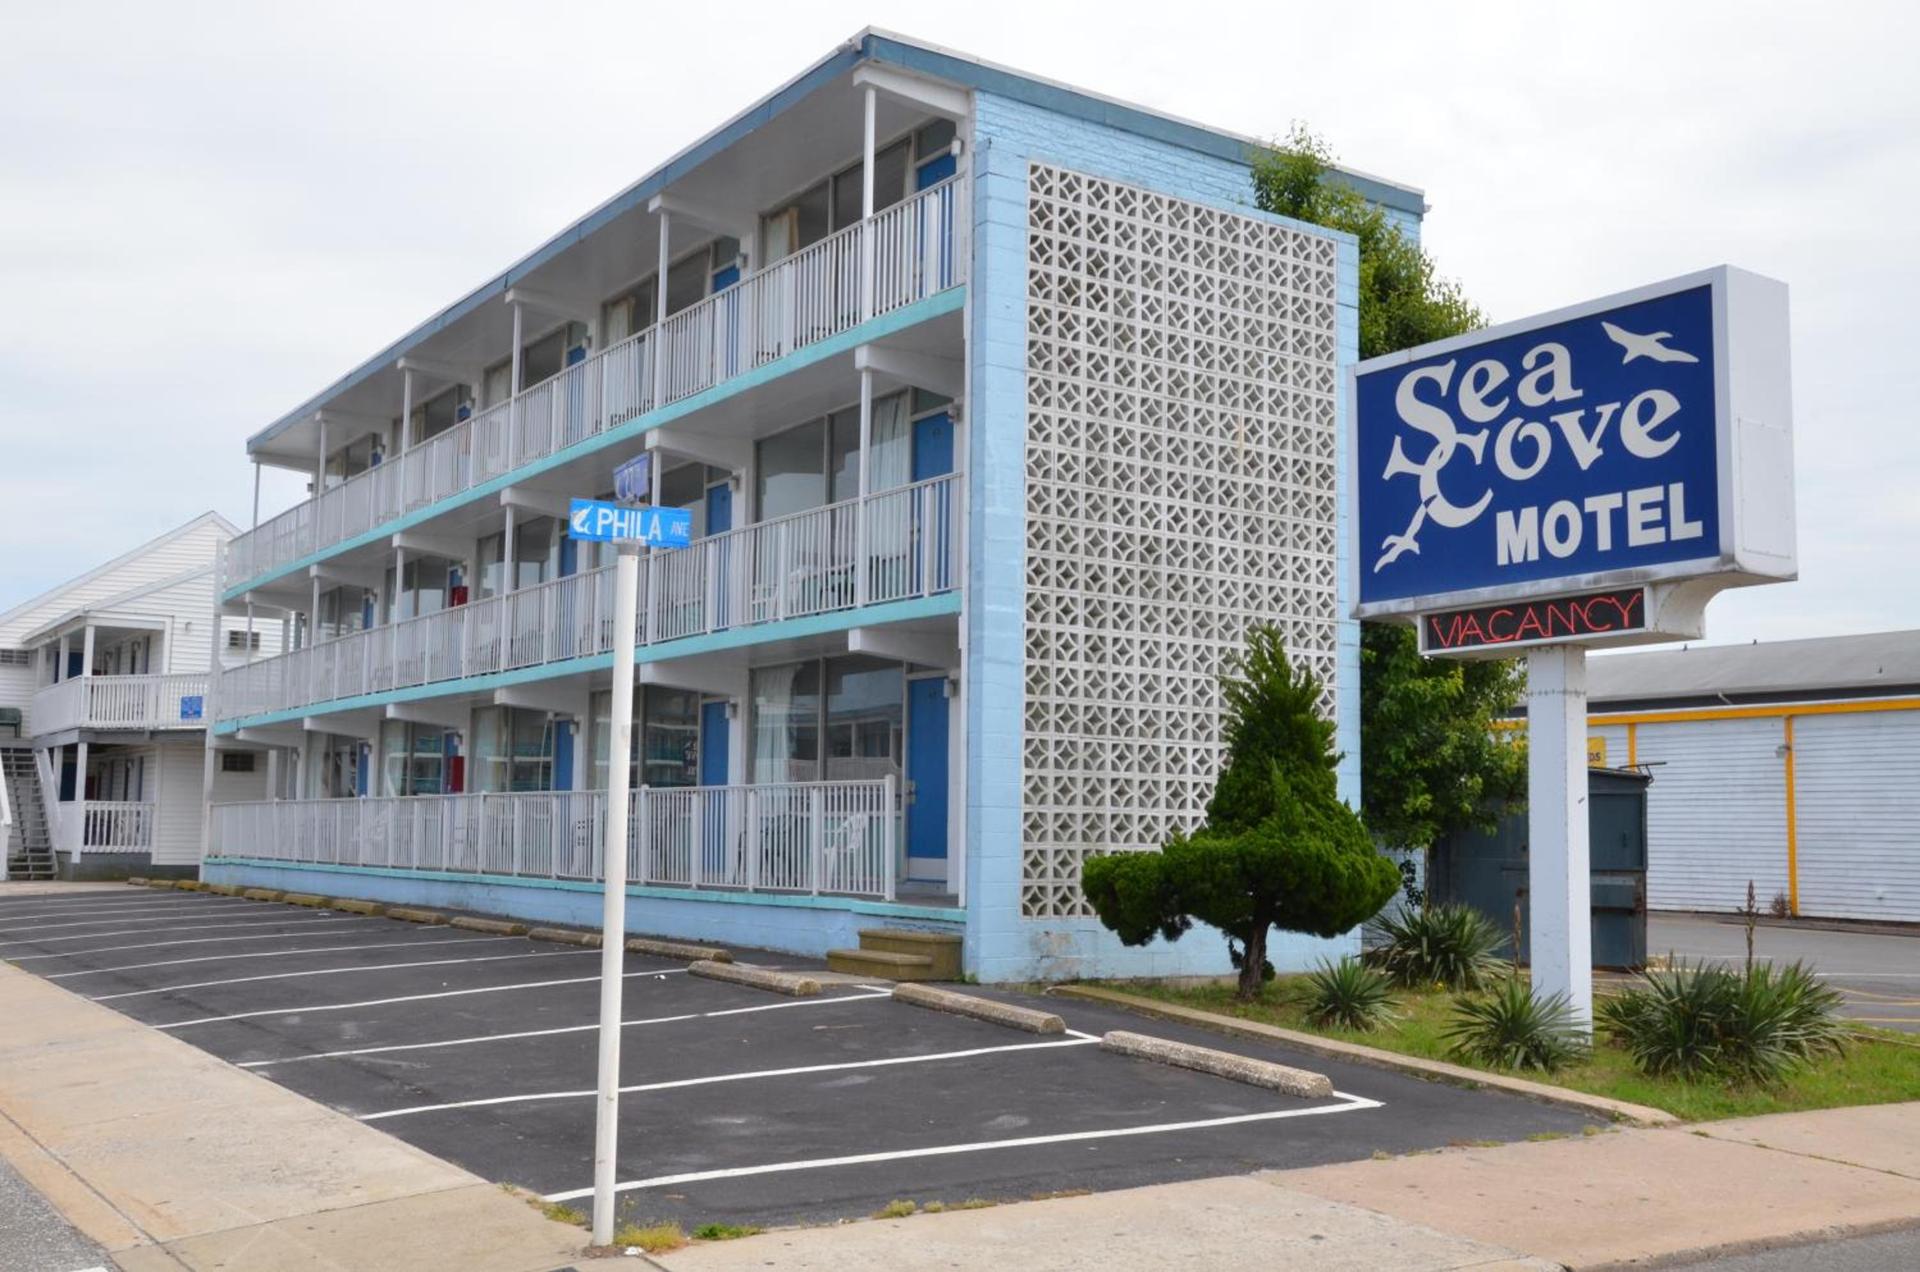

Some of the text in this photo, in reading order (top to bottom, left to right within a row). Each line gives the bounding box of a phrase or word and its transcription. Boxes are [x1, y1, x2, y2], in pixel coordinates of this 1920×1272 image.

[1383, 342, 1583, 479] Sea
[1420, 389, 1681, 528] Cove
[595, 508, 689, 541] PHILA AVE
[1496, 482, 1703, 566] MOTEL
[1431, 592, 1643, 648] VACANCY
